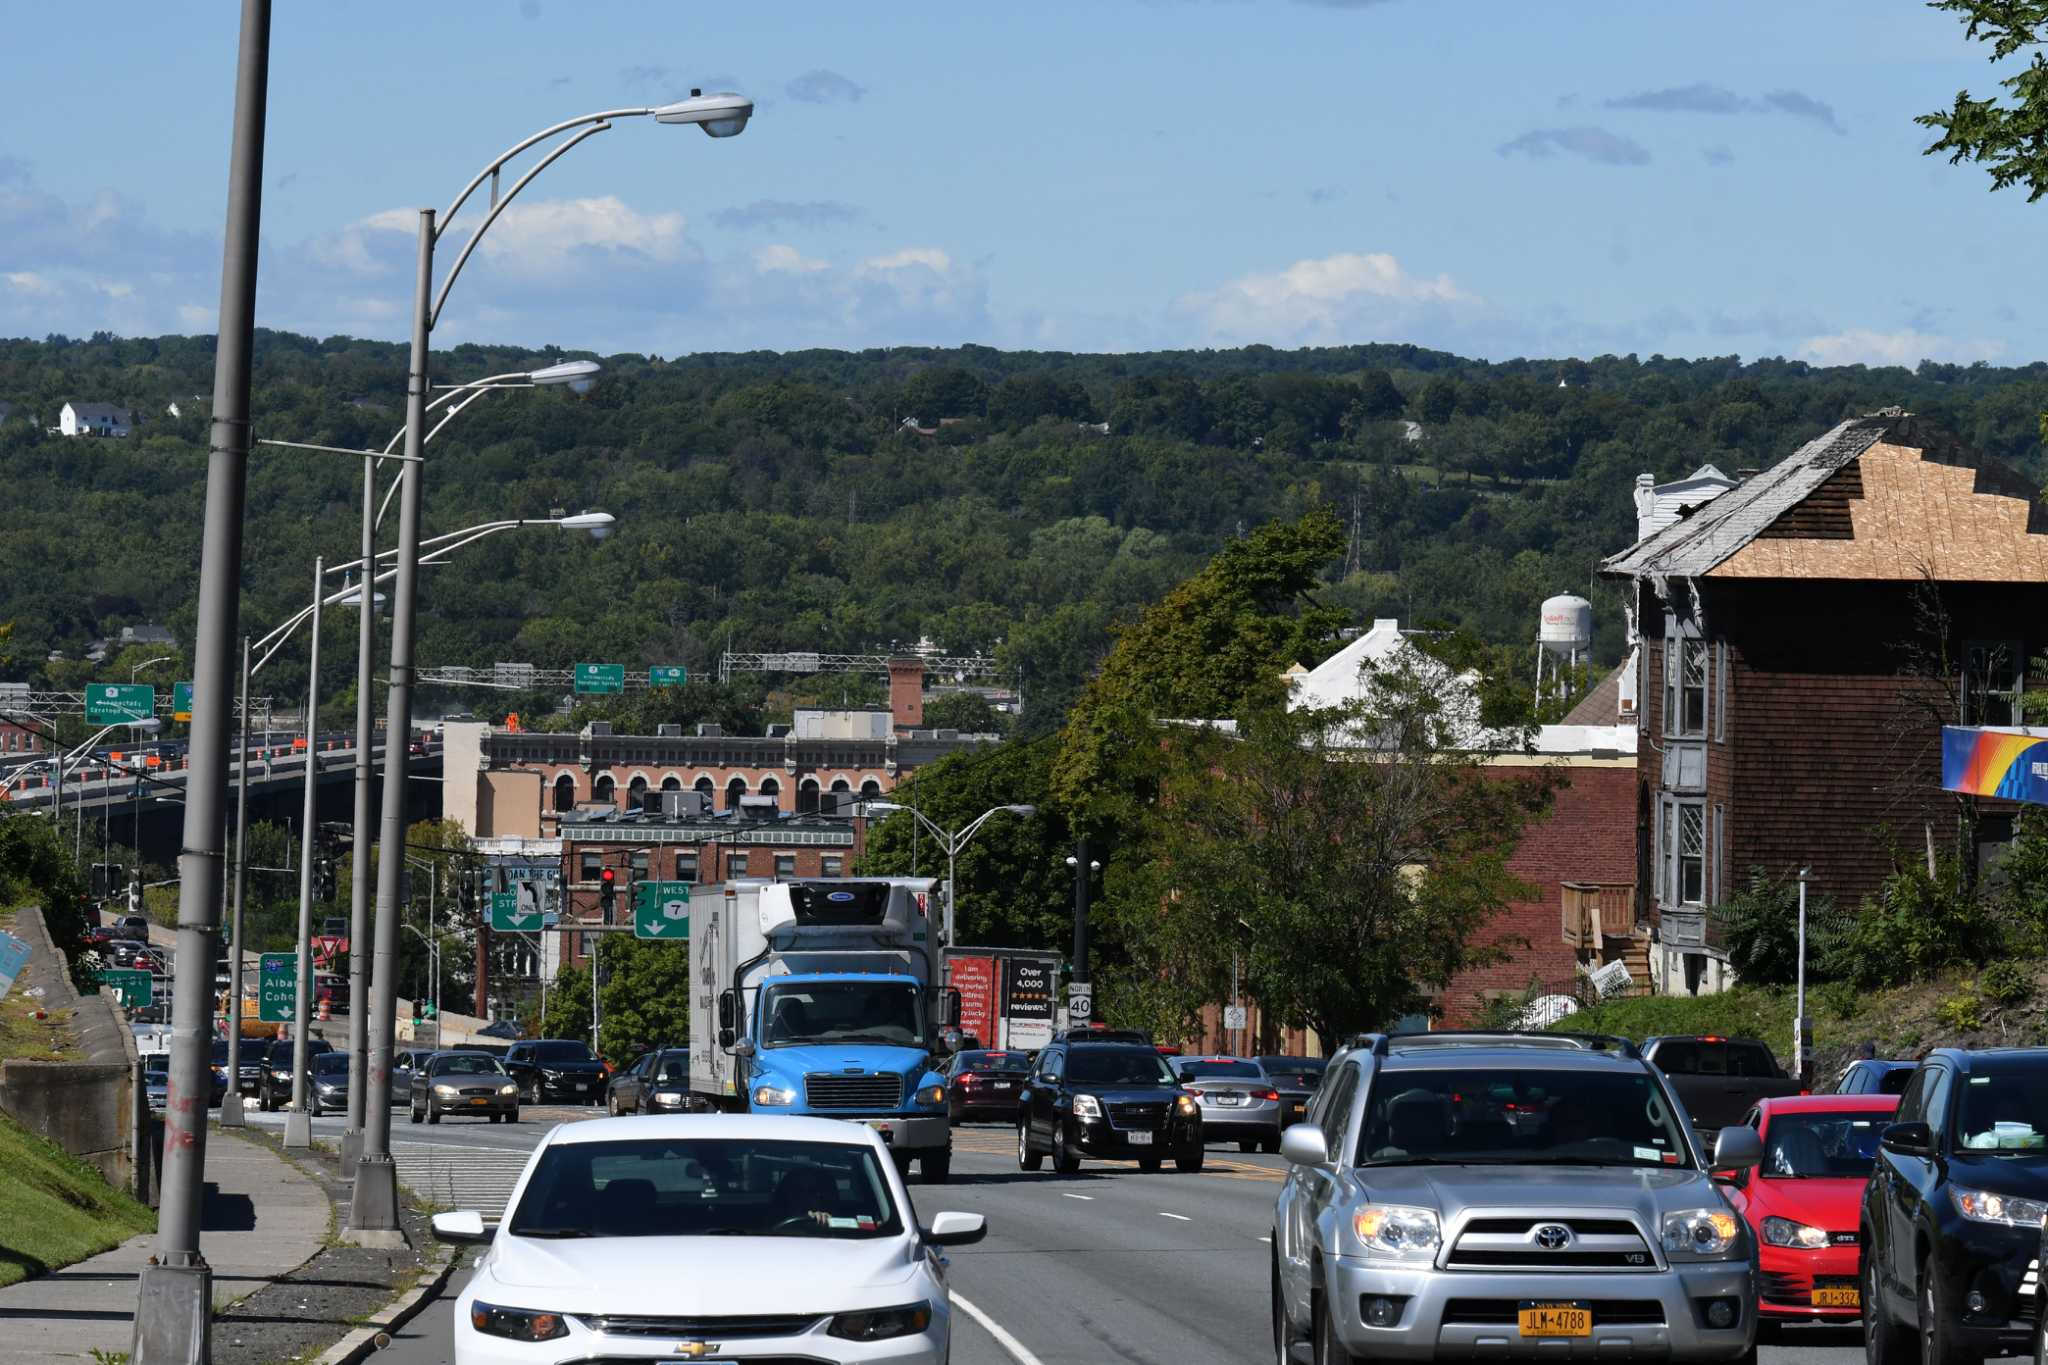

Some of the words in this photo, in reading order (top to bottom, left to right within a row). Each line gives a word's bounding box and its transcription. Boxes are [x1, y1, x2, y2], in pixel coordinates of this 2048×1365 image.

[663, 886, 689, 894] WEST
[499, 899, 517, 908] STR
[671, 904, 682, 915] 7
[1020, 967, 1042, 977] Over
[265, 978, 297, 988] Alba
[965, 982, 989, 991] perfect
[1017, 979, 1043, 989] 4,000
[1069, 985, 1091, 993] NORTH
[265, 991, 296, 1001] Coho
[1010, 1003, 1047, 1012] reviews!
[1071, 1000, 1090, 1013] 40
